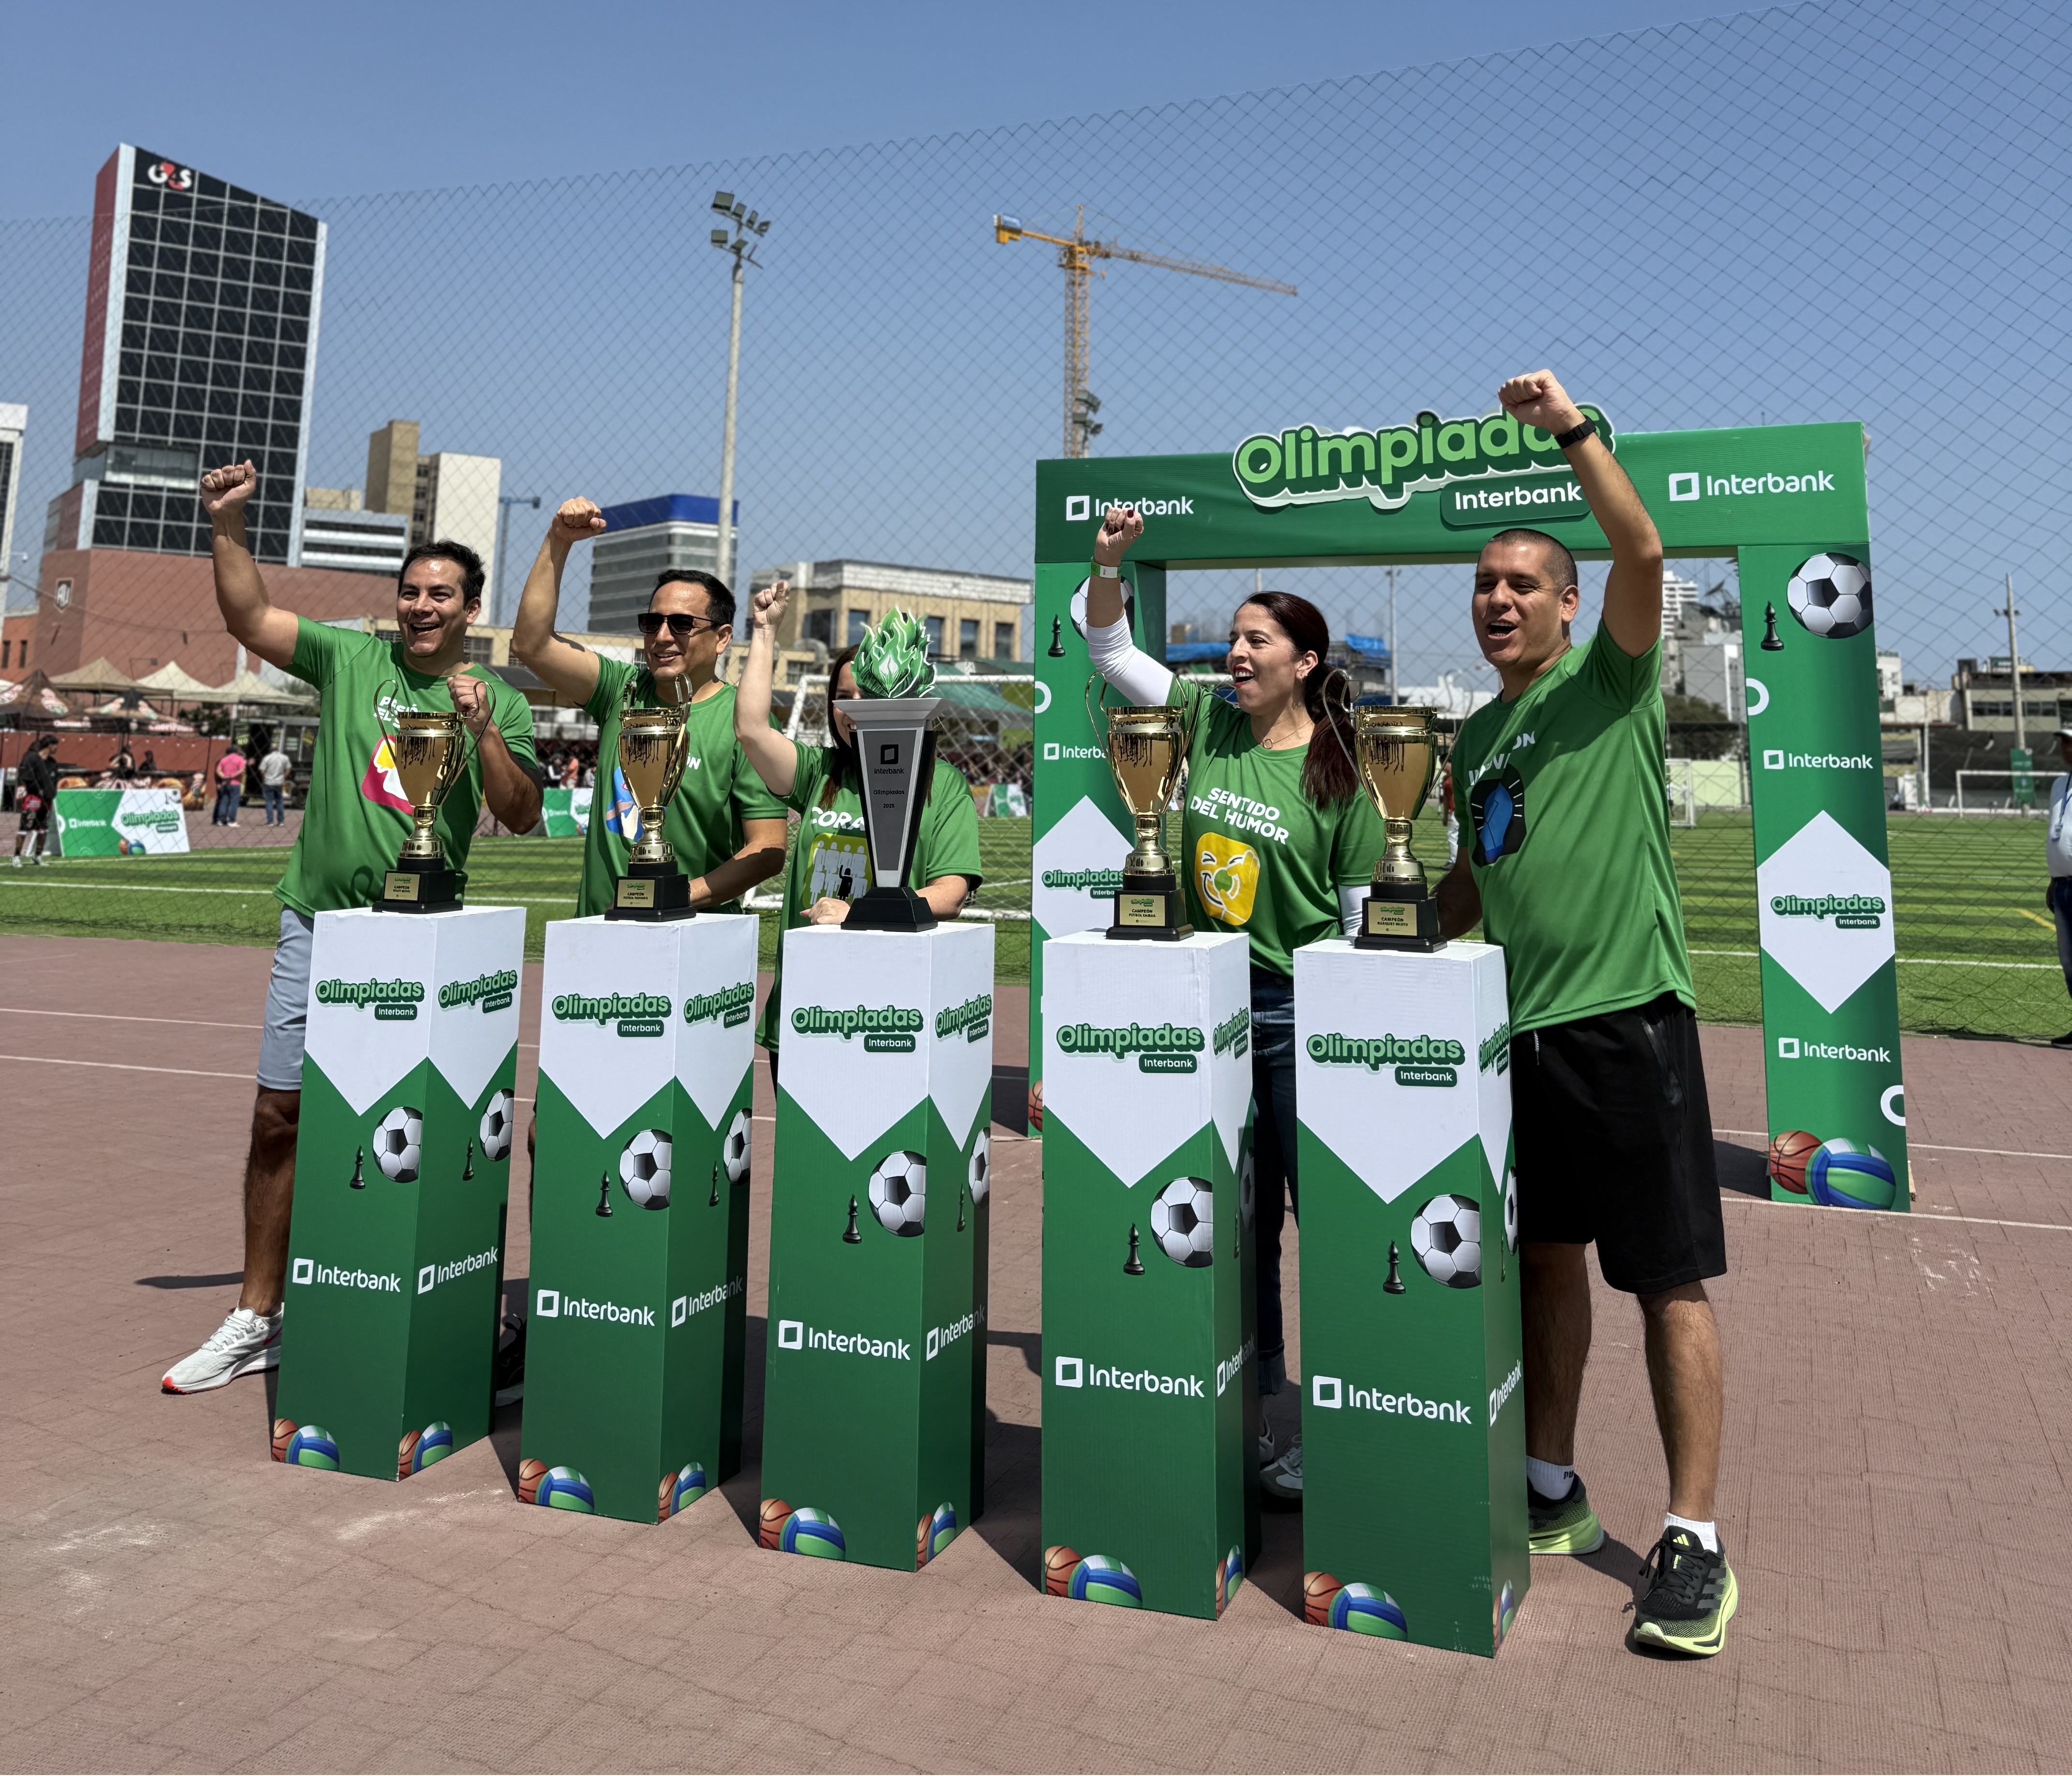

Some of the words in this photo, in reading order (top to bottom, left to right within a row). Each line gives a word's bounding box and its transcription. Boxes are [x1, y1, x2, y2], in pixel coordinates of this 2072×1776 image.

[148, 162, 192, 190] G4S
[1237, 407, 1601, 485] Olimpiada
[1454, 482, 1582, 511] Interbank
[1707, 470, 1835, 496] Interbank
[373, 707, 392, 722] EL
[1788, 752, 1873, 769] Interbank
[121, 810, 179, 827] Olimpiadas
[811, 806, 865, 831] CORA
[1208, 787, 1280, 821] SENTIDO
[1190, 795, 1219, 820] DEL
[1224, 808, 1289, 845] HUMOR
[1771, 895, 1884, 917] Olimpiadas
[1839, 917, 1877, 926] Interbank
[316, 978, 423, 1004] Olimpiadas
[439, 970, 517, 1003] Olimpiadas
[684, 982, 754, 1018] Olimpiadas
[378, 1008, 414, 1016] Interbank
[485, 996, 510, 1008] Interbank
[552, 993, 669, 1019] Olimpiadas
[725, 1010, 748, 1023] Interbank
[935, 994, 991, 1033] Olimpiadas
[621, 1024, 661, 1032] Interbank
[792, 1005, 921, 1034] Olimpiadas
[969, 1024, 988, 1037] Interbank
[1213, 1007, 1248, 1051] Olimpiadas
[868, 1038, 912, 1047] Interbank
[1057, 1023, 1201, 1053] Olimpiadas
[1306, 1033, 1462, 1064] Olimpiadas
[1479, 1022, 1509, 1068] Olimpiadas
[1804, 1041, 1891, 1063] Interbank
[1144, 1059, 1193, 1068] Interbank
[1400, 1071, 1452, 1081] Interbank
[317, 1264, 401, 1292] Interbank
[437, 1246, 498, 1283] Interbank
[689, 1275, 743, 1316] Interbank
[563, 1296, 655, 1327] Interbank
[940, 1304, 985, 1348] Interbank
[808, 1327, 911, 1360] Interbank
[1226, 1333, 1255, 1382] Interbank
[1089, 1364, 1205, 1398] Interbank
[1496, 1359, 1522, 1412] Interbank
[1348, 1384, 1472, 1424] Interbank
